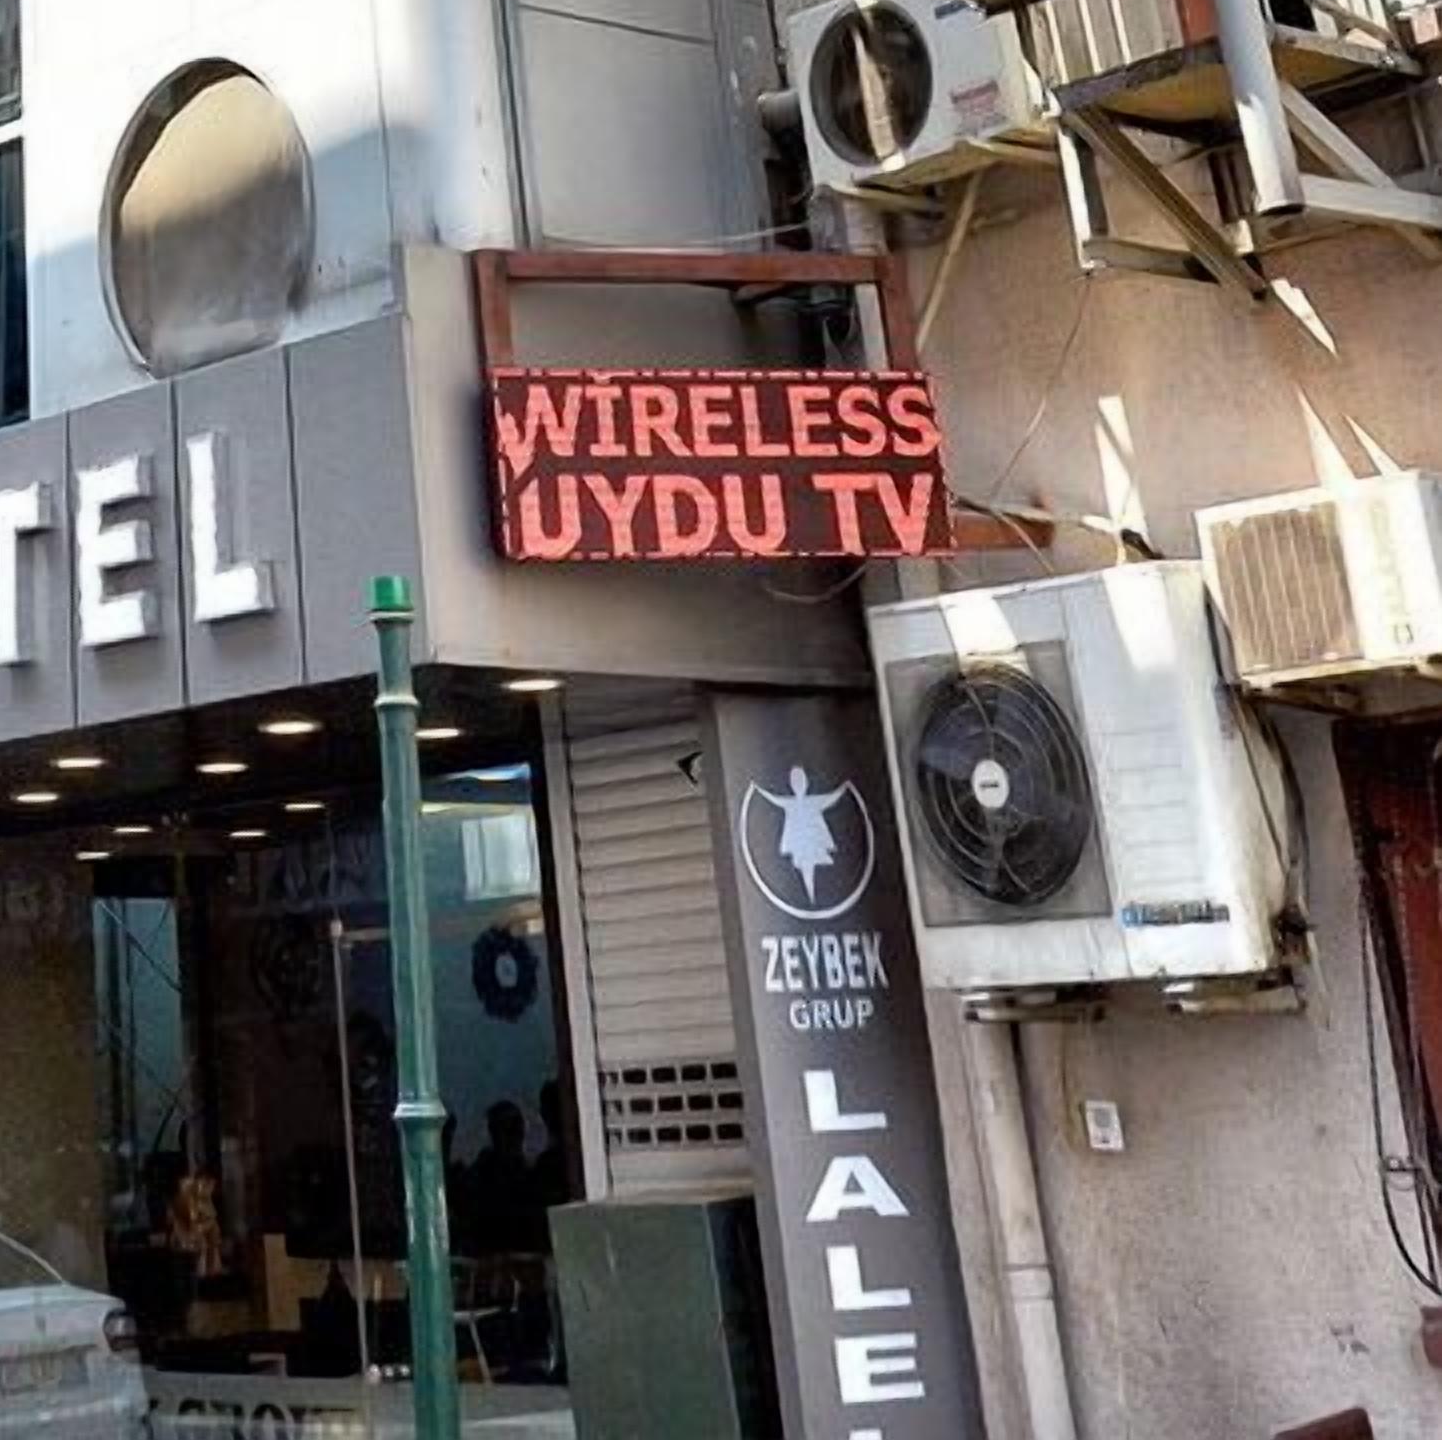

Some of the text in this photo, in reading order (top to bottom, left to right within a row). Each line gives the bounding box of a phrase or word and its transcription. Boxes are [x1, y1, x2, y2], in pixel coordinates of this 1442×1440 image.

[516, 472, 934, 559] UYDU TV
[761, 932, 889, 993] ZEYBEK
[789, 997, 875, 1031] GRUP
[802, 1068, 926, 1440] LALE
